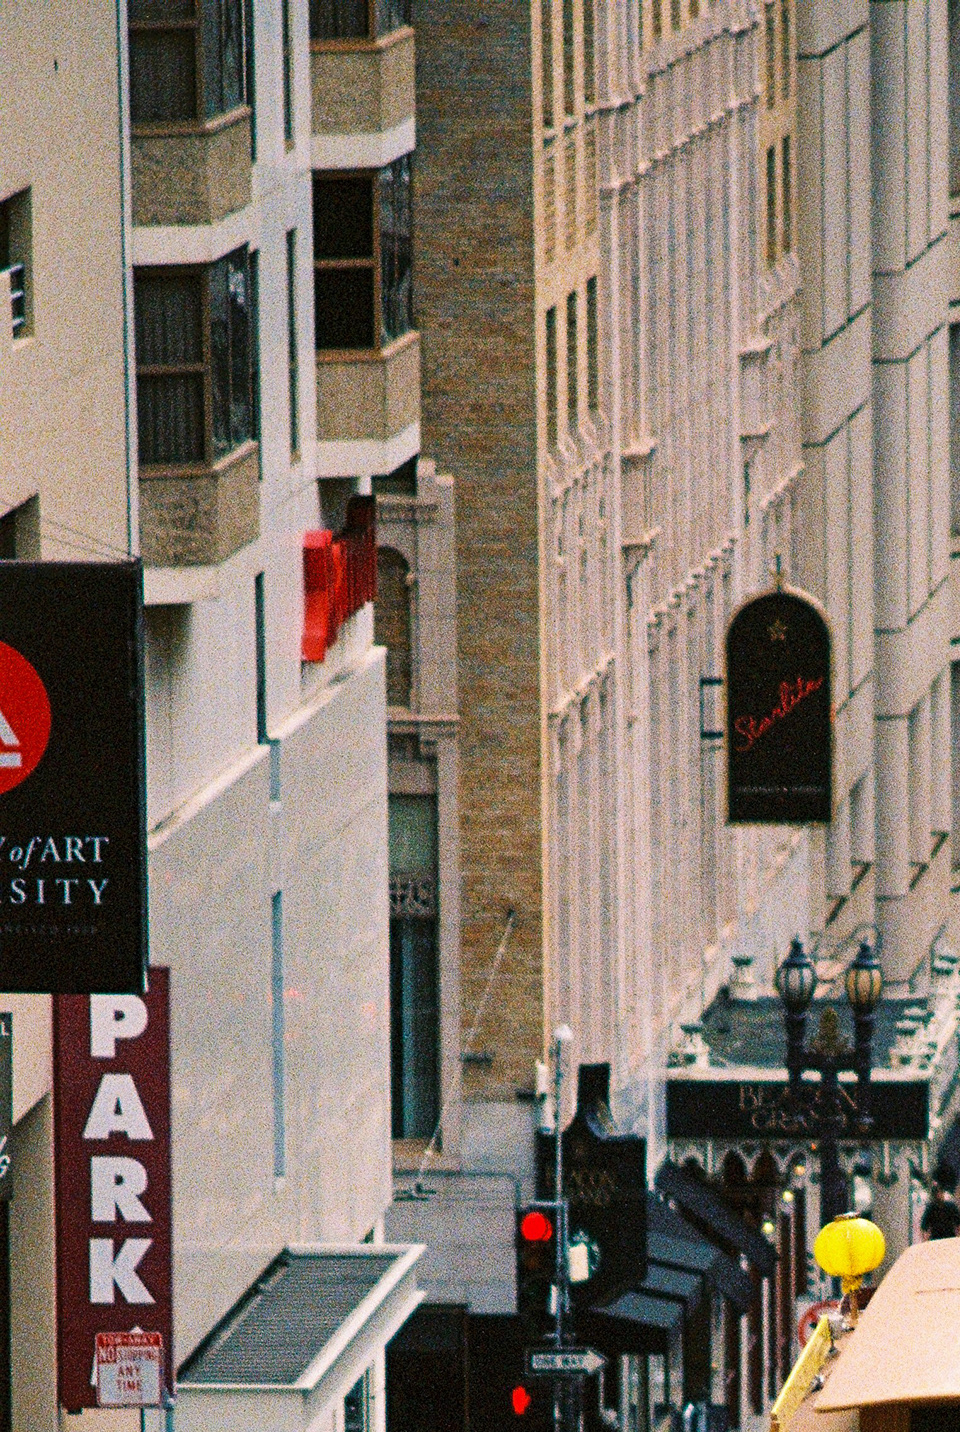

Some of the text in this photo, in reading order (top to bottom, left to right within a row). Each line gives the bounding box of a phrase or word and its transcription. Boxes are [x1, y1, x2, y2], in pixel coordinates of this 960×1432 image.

[9, 836, 42, 871] of
[40, 836, 110, 862] ART
[0, 878, 109, 905] SITY
[83, 993, 155, 1306] PARK
[98, 1346, 116, 1362] NO
[117, 1365, 141, 1377] ANY
